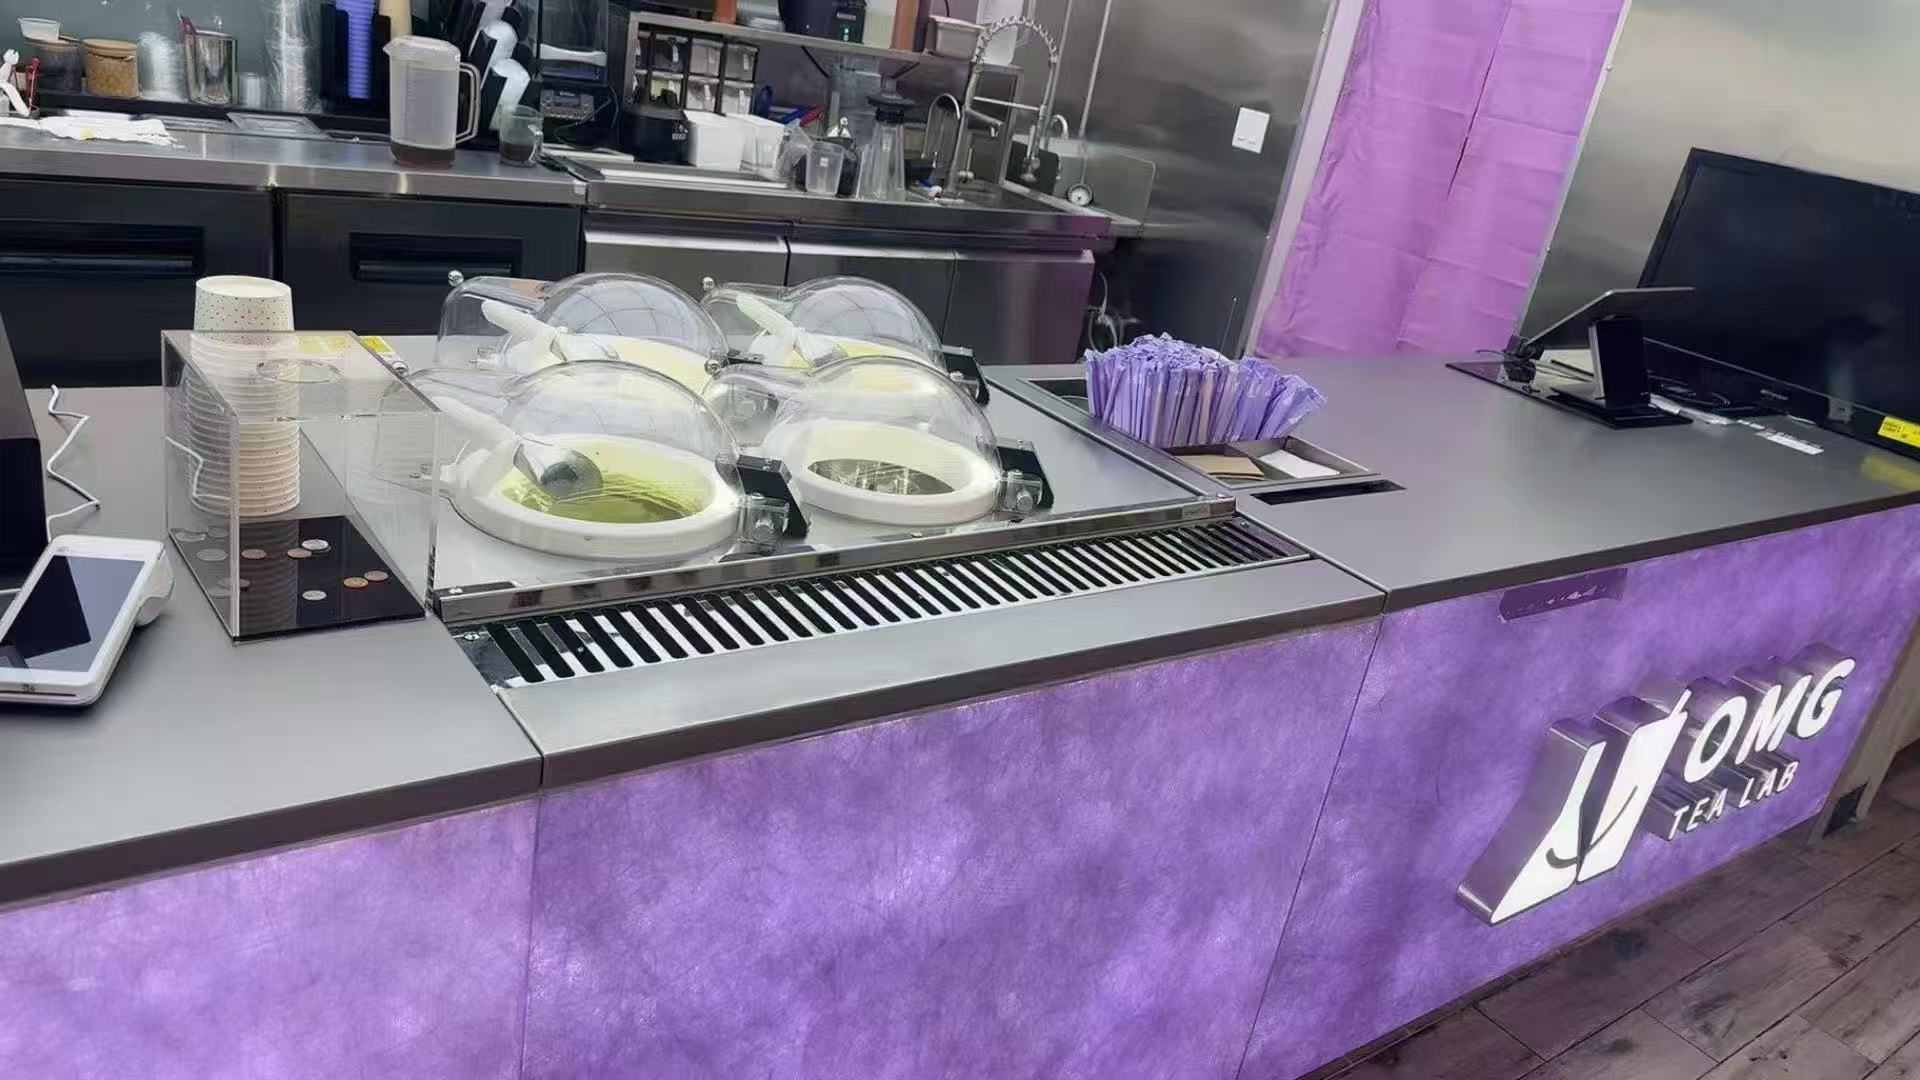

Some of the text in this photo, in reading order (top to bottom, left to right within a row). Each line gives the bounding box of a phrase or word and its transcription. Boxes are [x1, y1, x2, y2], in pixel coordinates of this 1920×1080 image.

[1684, 658, 1856, 783] OMG
[1668, 761, 1800, 840] TEA LAB
